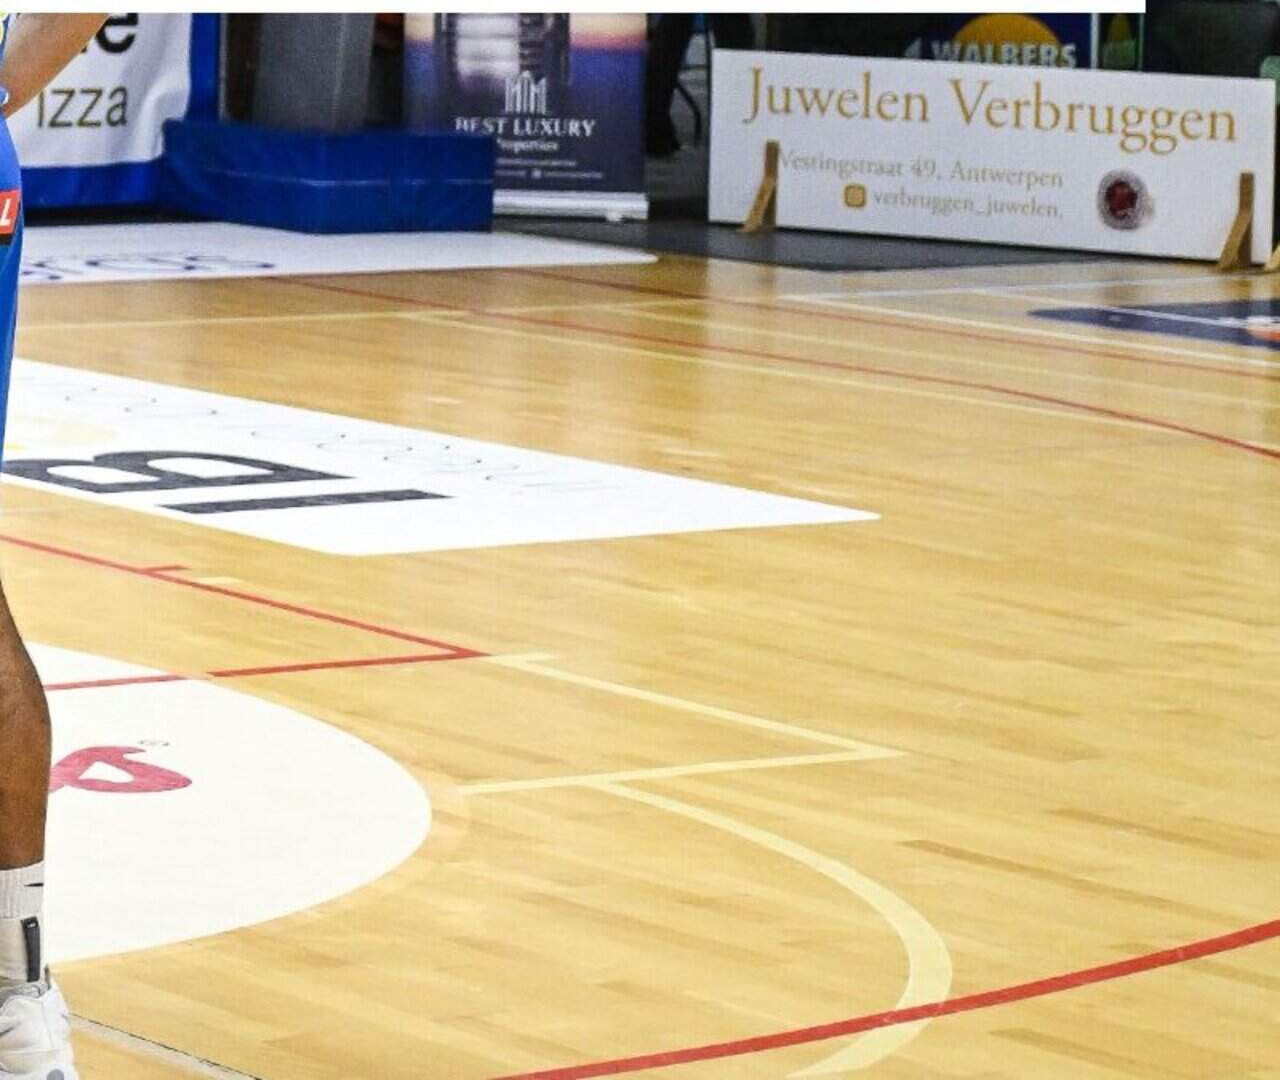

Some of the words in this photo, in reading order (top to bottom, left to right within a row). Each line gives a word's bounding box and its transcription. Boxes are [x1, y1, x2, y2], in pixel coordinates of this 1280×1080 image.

[513, 118, 597, 137] LUXURY
[742, 67, 929, 124] Juwelen
[950, 78, 1237, 156] Verbruggen
[779, 150, 903, 180] Vestingstraat
[951, 163, 1064, 192] Antwerpen
